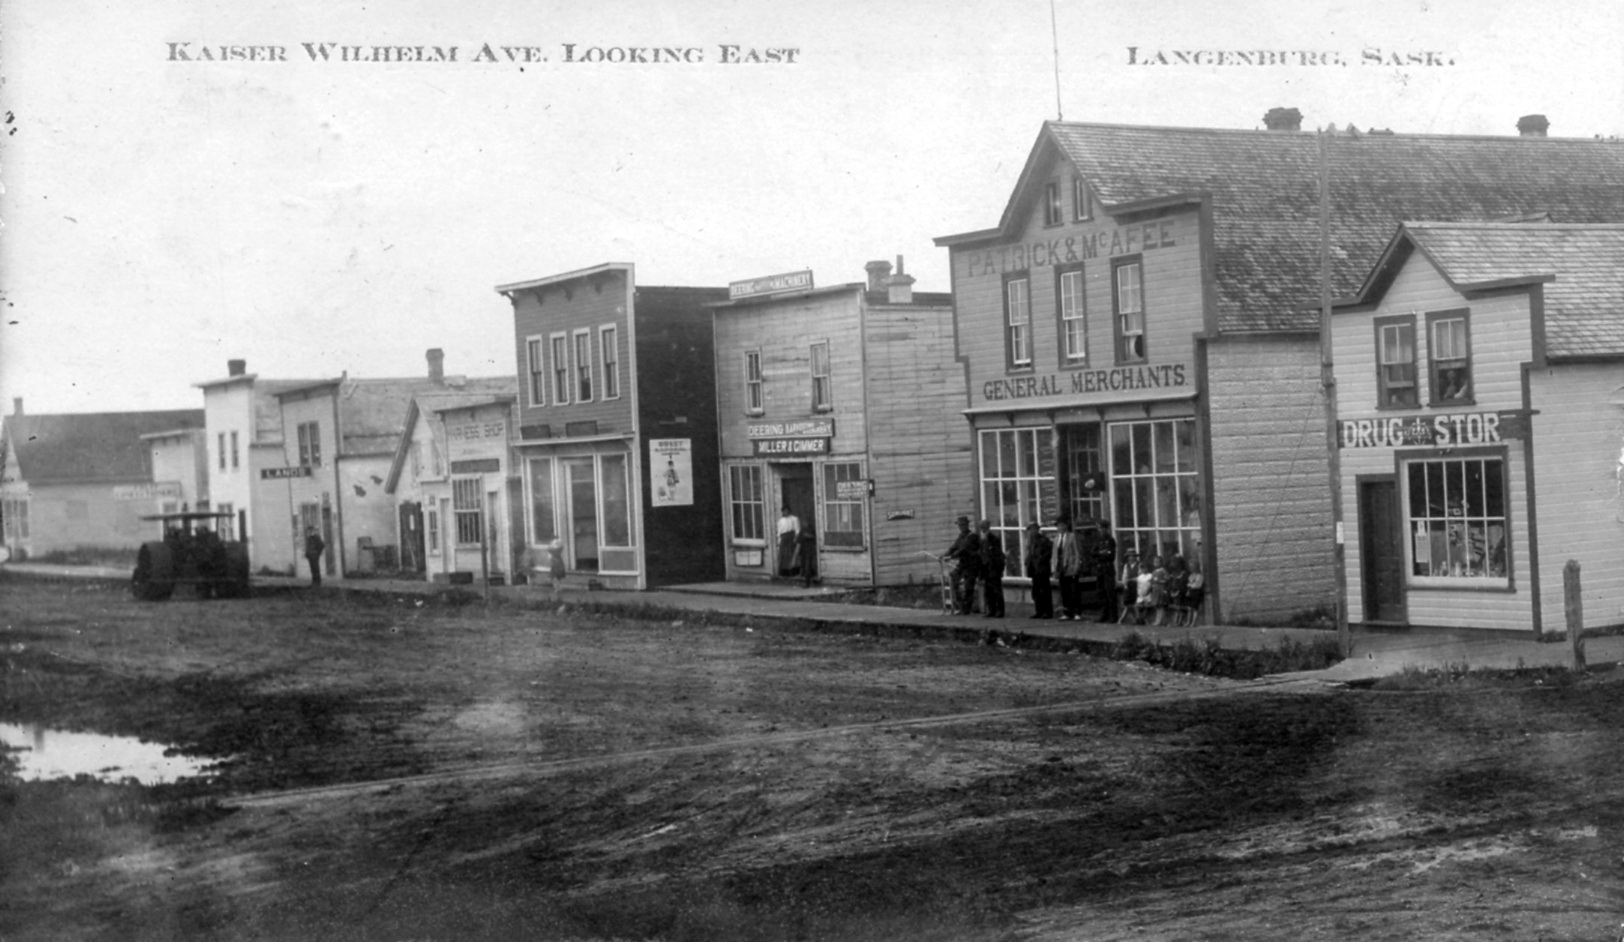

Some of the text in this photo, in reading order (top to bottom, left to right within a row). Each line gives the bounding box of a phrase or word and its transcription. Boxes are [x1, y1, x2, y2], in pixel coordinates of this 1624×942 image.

[967, 242, 1061, 277] PATRICK
[1065, 242, 1078, 261] &
[983, 374, 1063, 401] GENERAL
[484, 422, 504, 438] SHOP
[748, 424, 783, 437] DEERING
[1343, 413, 1516, 448] DRUG STOR
[758, 440, 788, 453] MILLER
